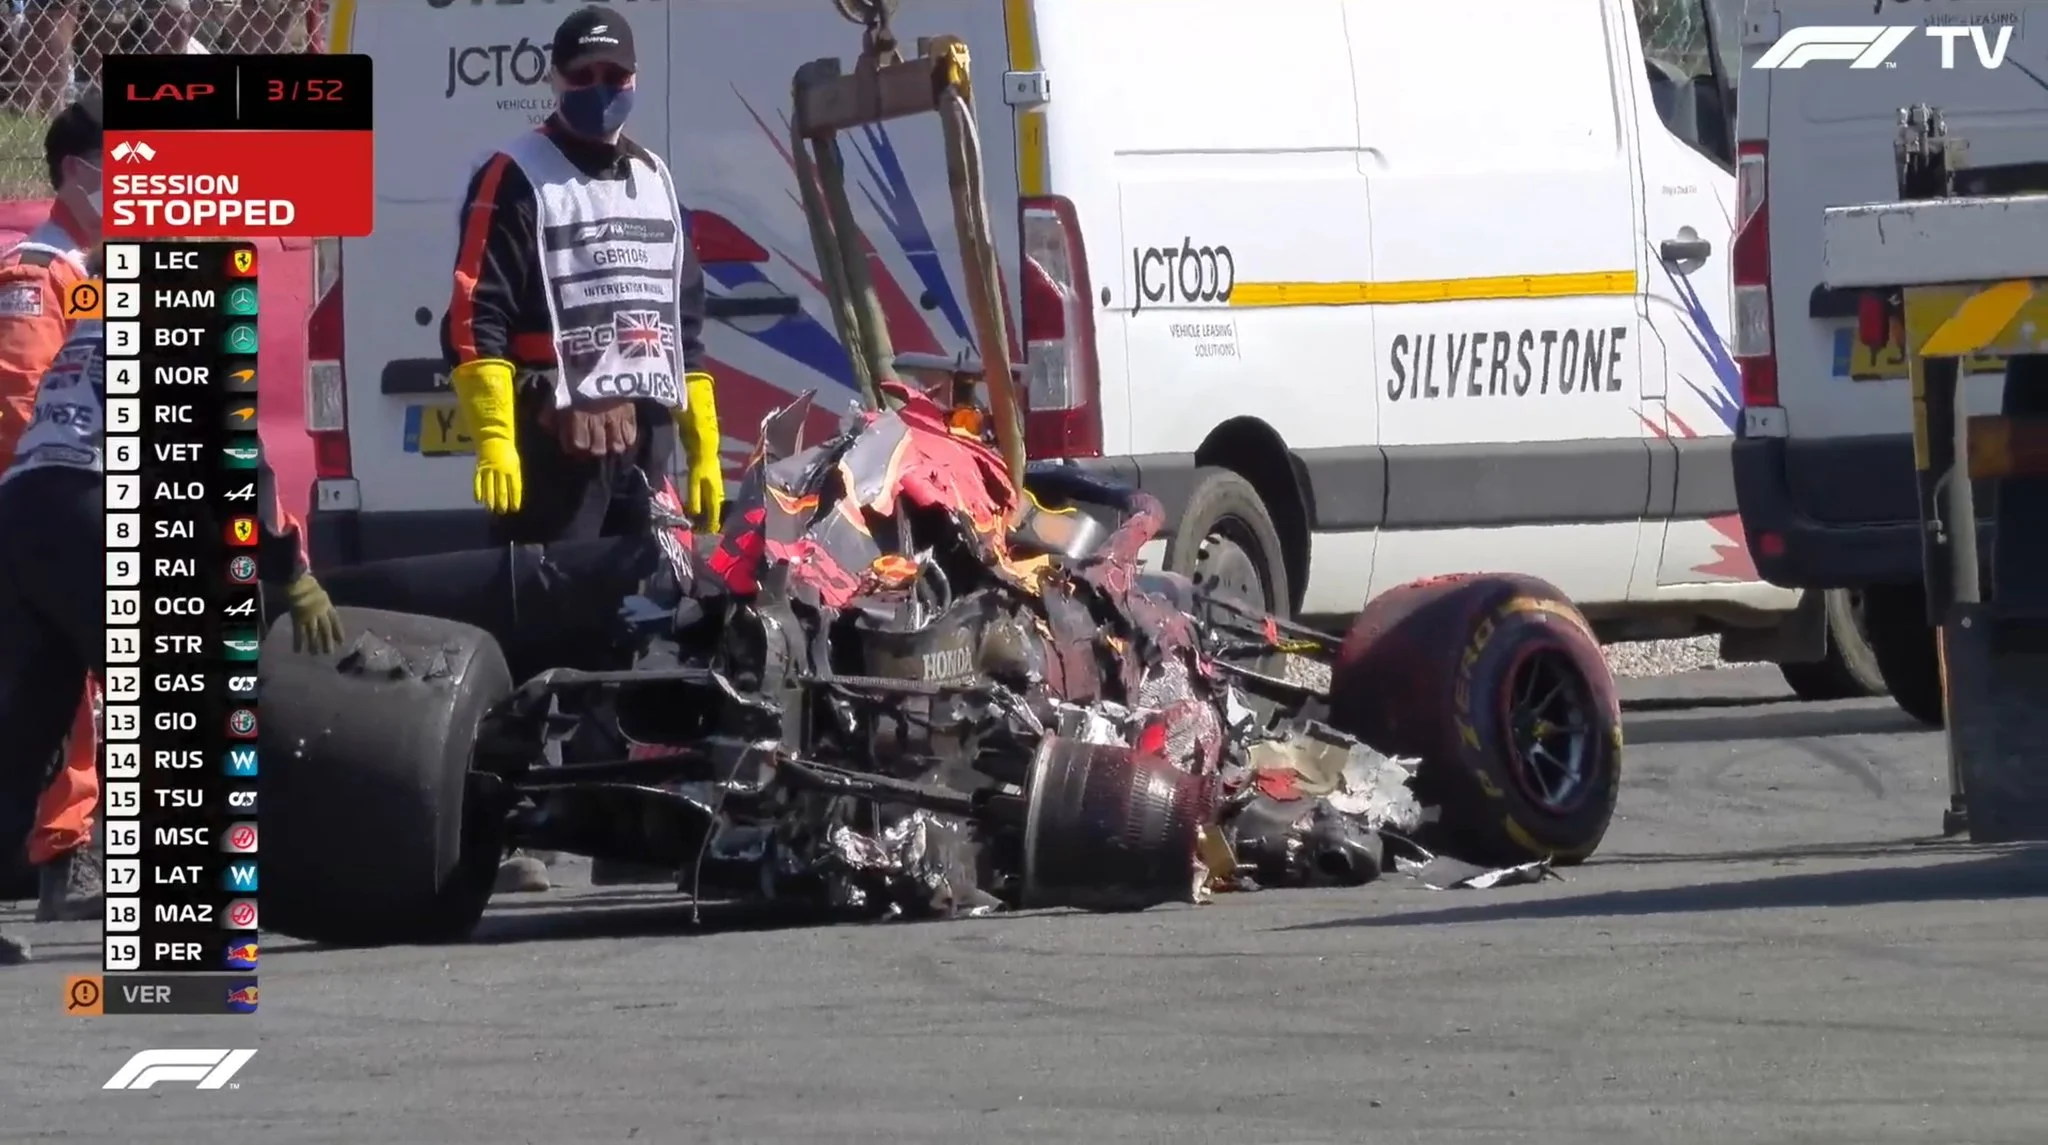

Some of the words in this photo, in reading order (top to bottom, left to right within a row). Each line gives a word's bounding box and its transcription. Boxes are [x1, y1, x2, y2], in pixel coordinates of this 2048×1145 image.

[496, 98, 537, 110] VEHICLE
[1131, 235, 1235, 318] JCT600
[1168, 323, 1201, 338] VEHICLE
[1202, 323, 1233, 338] LEASING
[1194, 342, 1236, 358] SOLUTIONS
[1386, 326, 1627, 402] SILVERSTONE
[924, 647, 973, 679] HONDA
